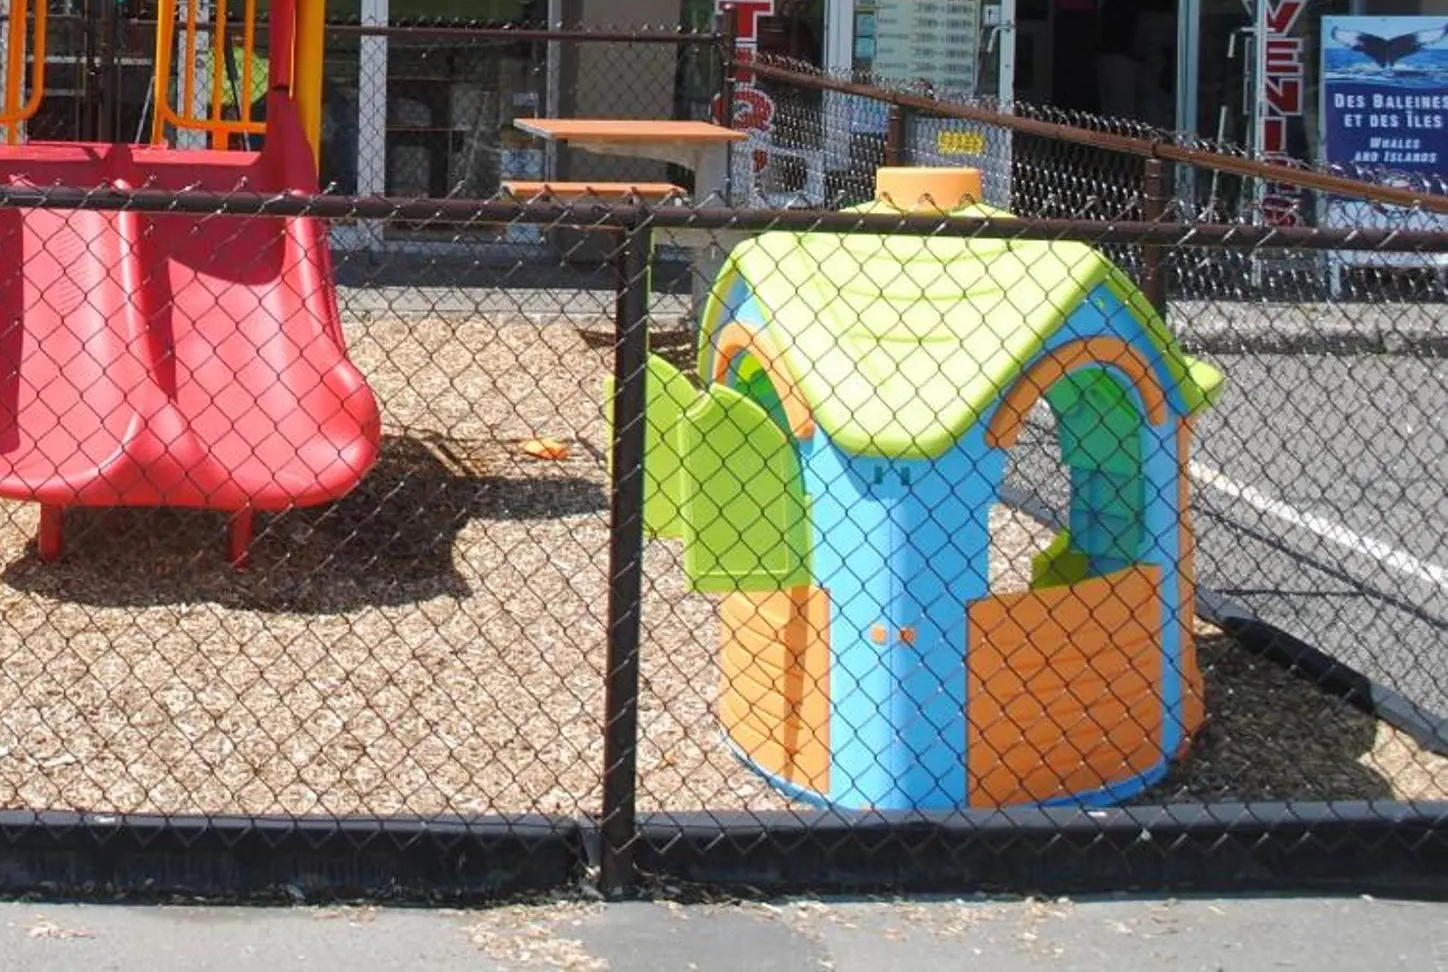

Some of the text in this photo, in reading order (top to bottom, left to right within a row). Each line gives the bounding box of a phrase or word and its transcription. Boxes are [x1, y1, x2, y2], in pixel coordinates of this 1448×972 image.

[1334, 93, 1365, 109] DES
[1344, 114, 1362, 128] ET
[1370, 114, 1398, 128] DES
[1370, 137, 1420, 149] WHALES
